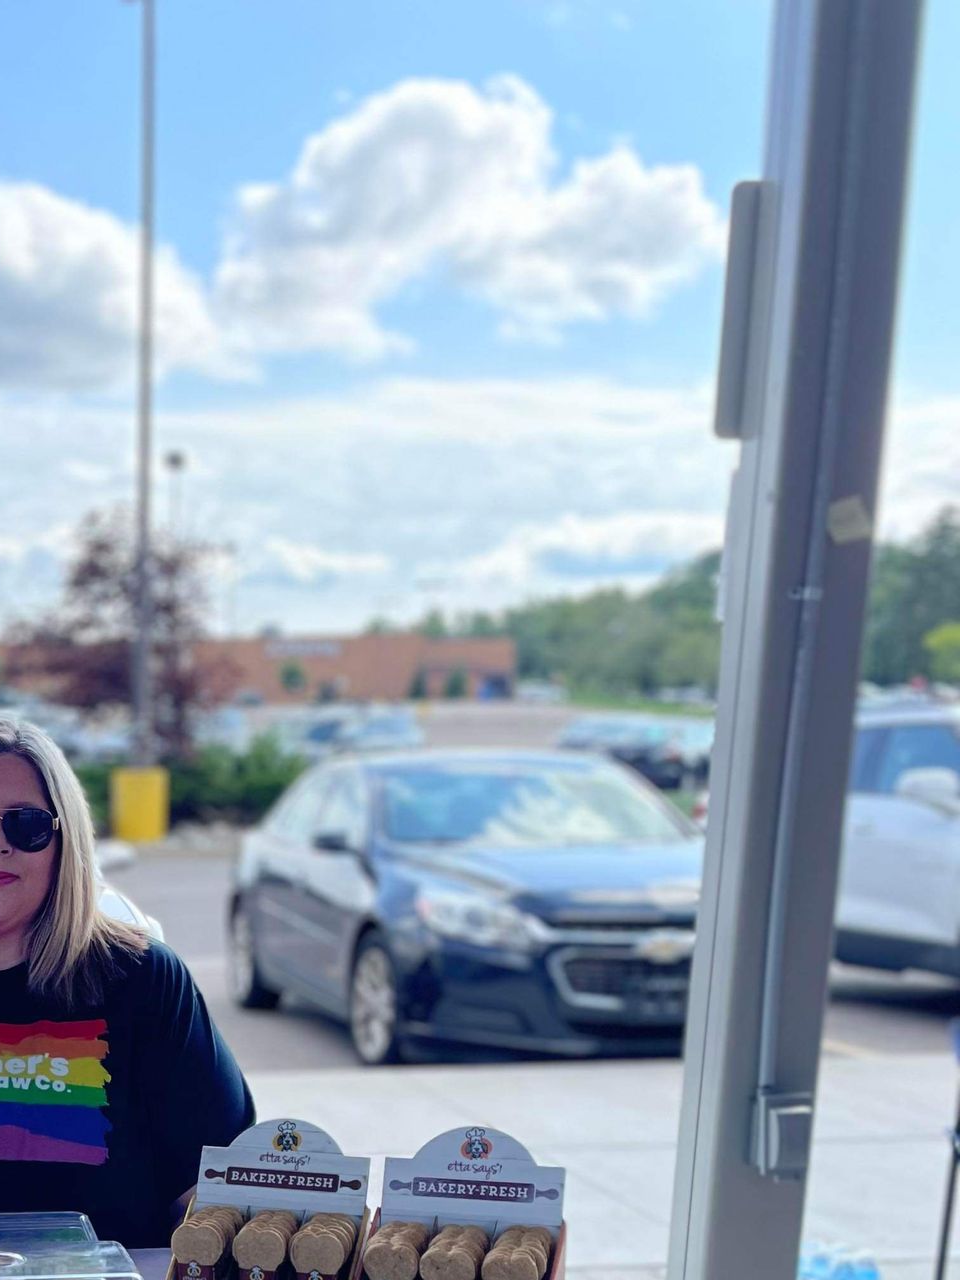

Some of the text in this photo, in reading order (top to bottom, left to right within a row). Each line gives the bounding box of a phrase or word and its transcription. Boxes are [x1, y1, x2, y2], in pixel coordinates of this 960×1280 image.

[35, 1075, 71, 1093] Co.
[231, 1170, 334, 1189] BAKERY-FRESH
[418, 1181, 529, 1199] BAKERY-FRESH
